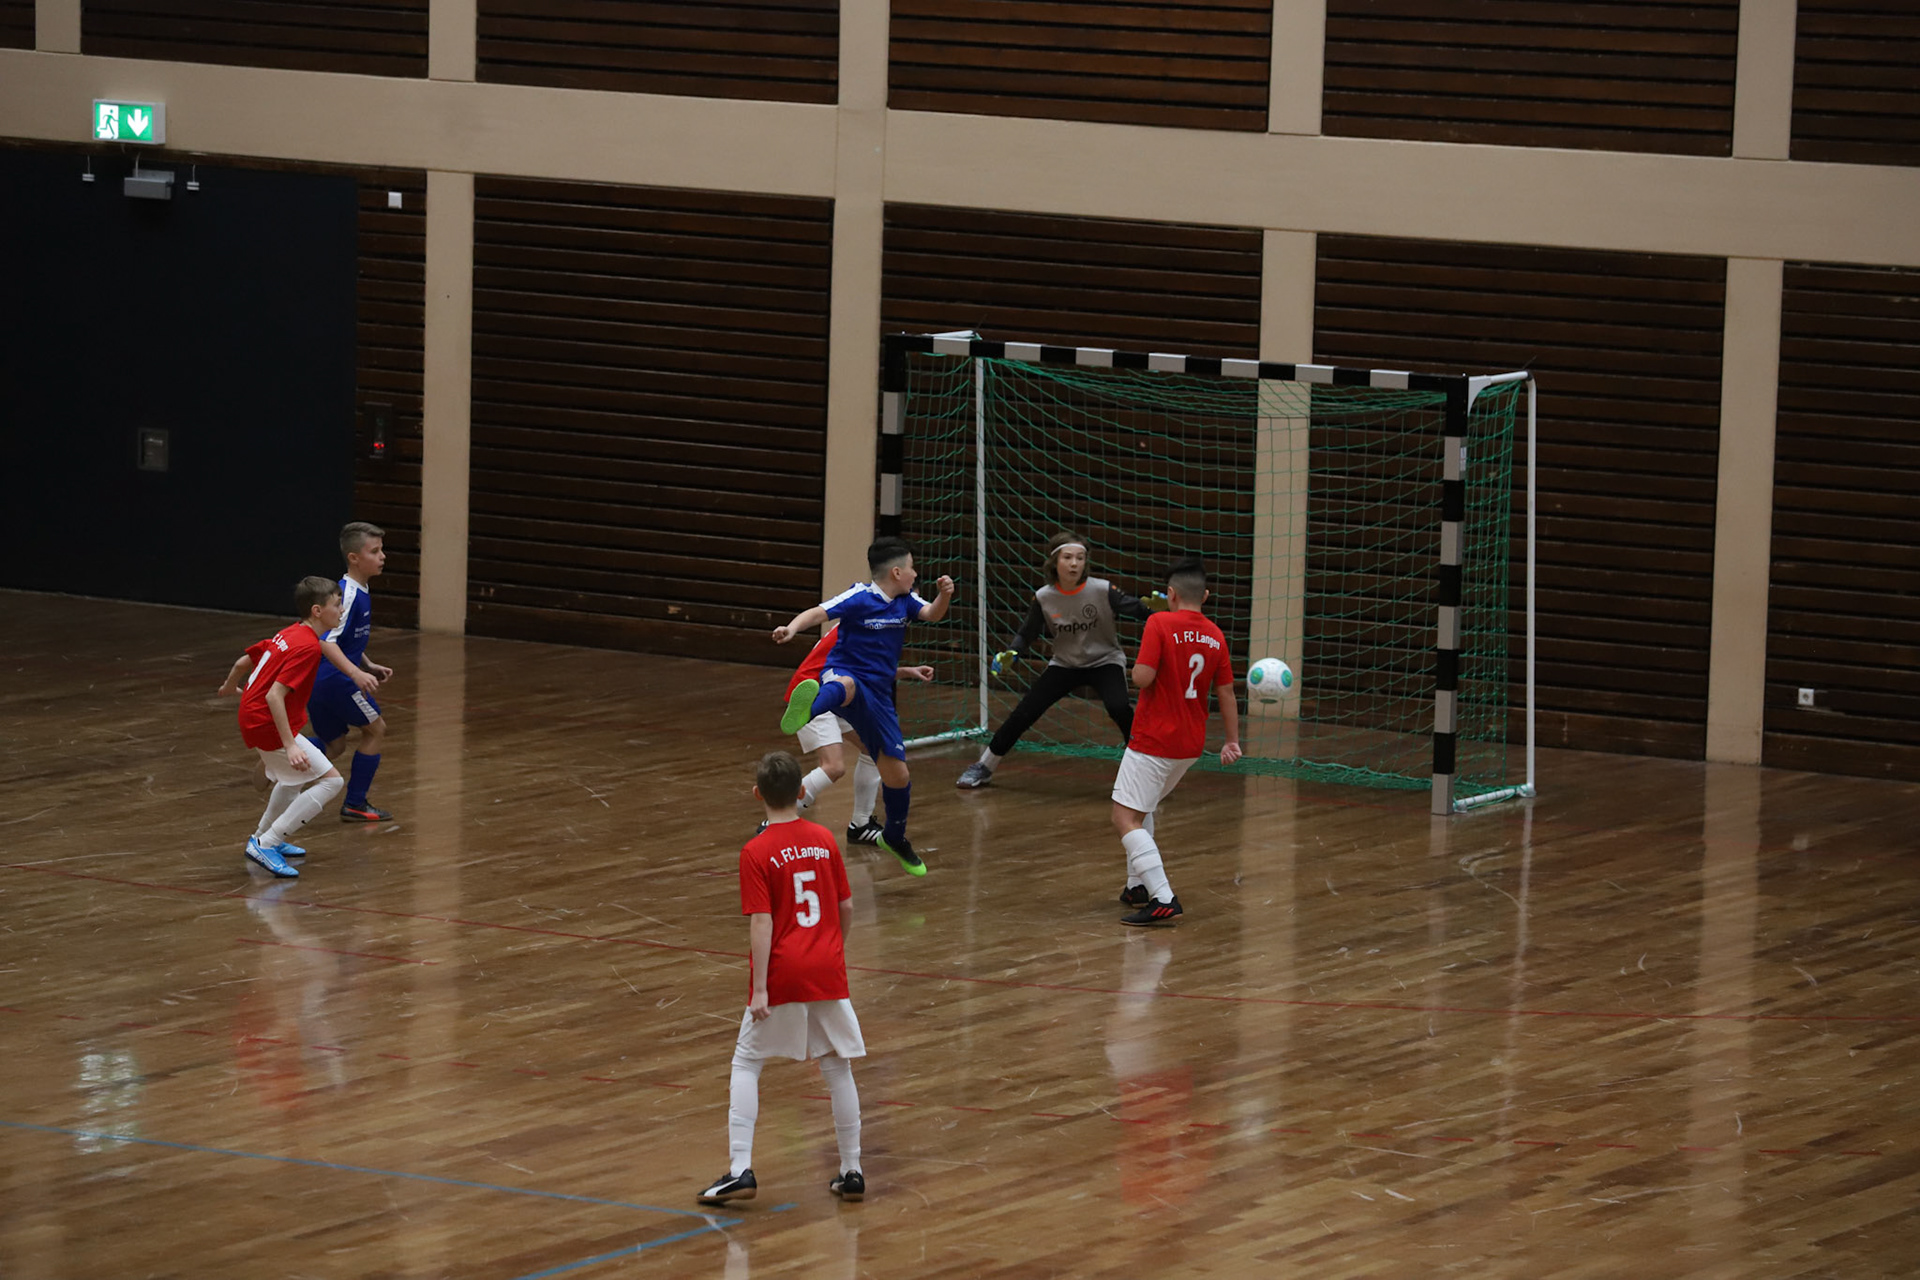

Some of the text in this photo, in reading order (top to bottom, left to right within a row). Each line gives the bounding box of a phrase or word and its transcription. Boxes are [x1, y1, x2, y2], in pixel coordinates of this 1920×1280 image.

[1173, 630, 1221, 651] 1. FC Langen
[1184, 653, 1205, 699] 2
[770, 846, 831, 869] 1. FC Langen
[793, 869, 821, 928] 5
